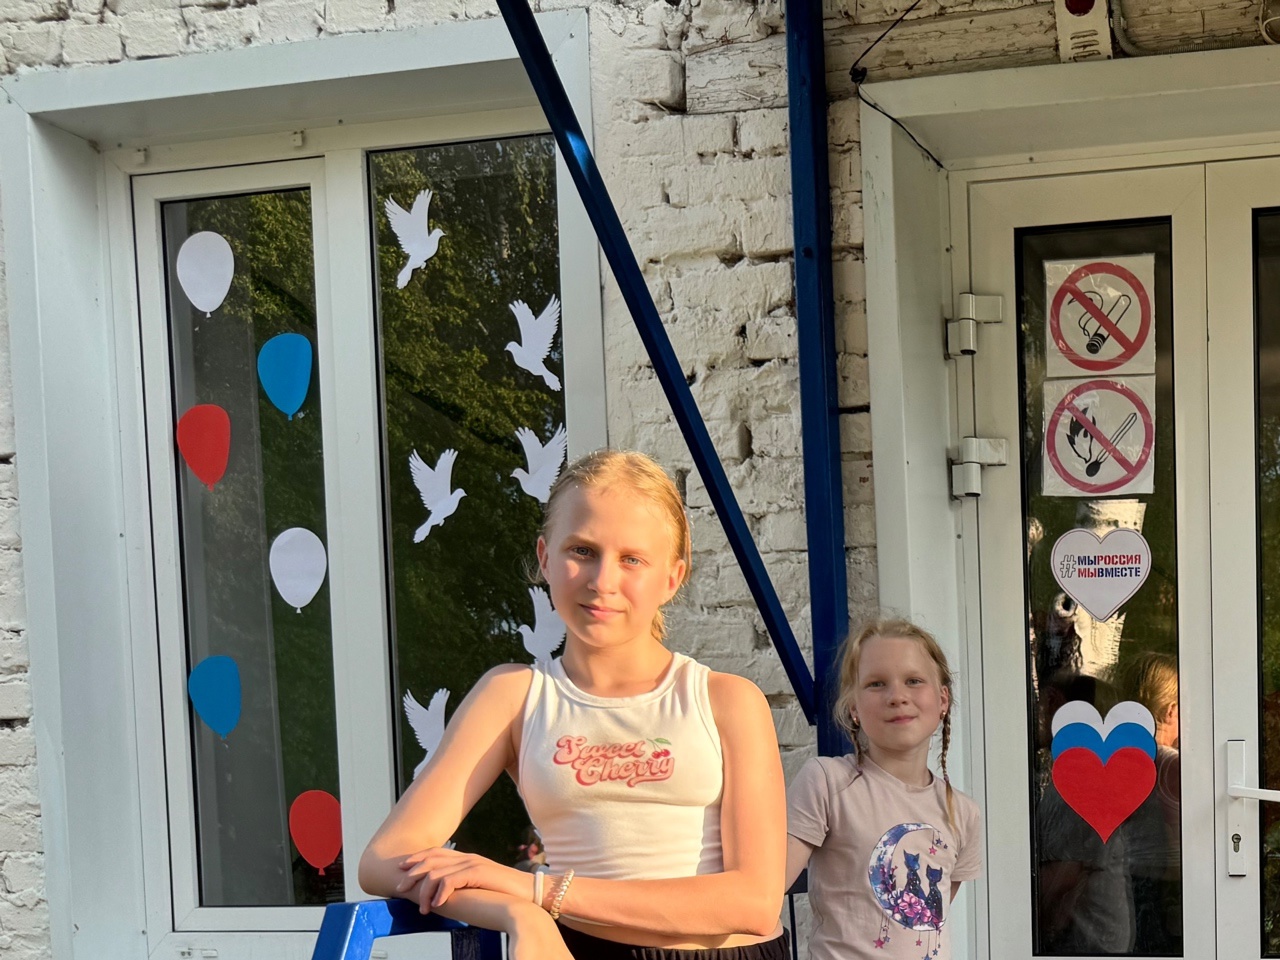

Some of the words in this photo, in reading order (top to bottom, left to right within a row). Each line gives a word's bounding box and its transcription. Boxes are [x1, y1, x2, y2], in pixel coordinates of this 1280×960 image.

[1077, 566, 1141, 578] МЫВМЕСТЕ
[553, 735, 647, 765] Sweet
[571, 756, 675, 788] Cherry
